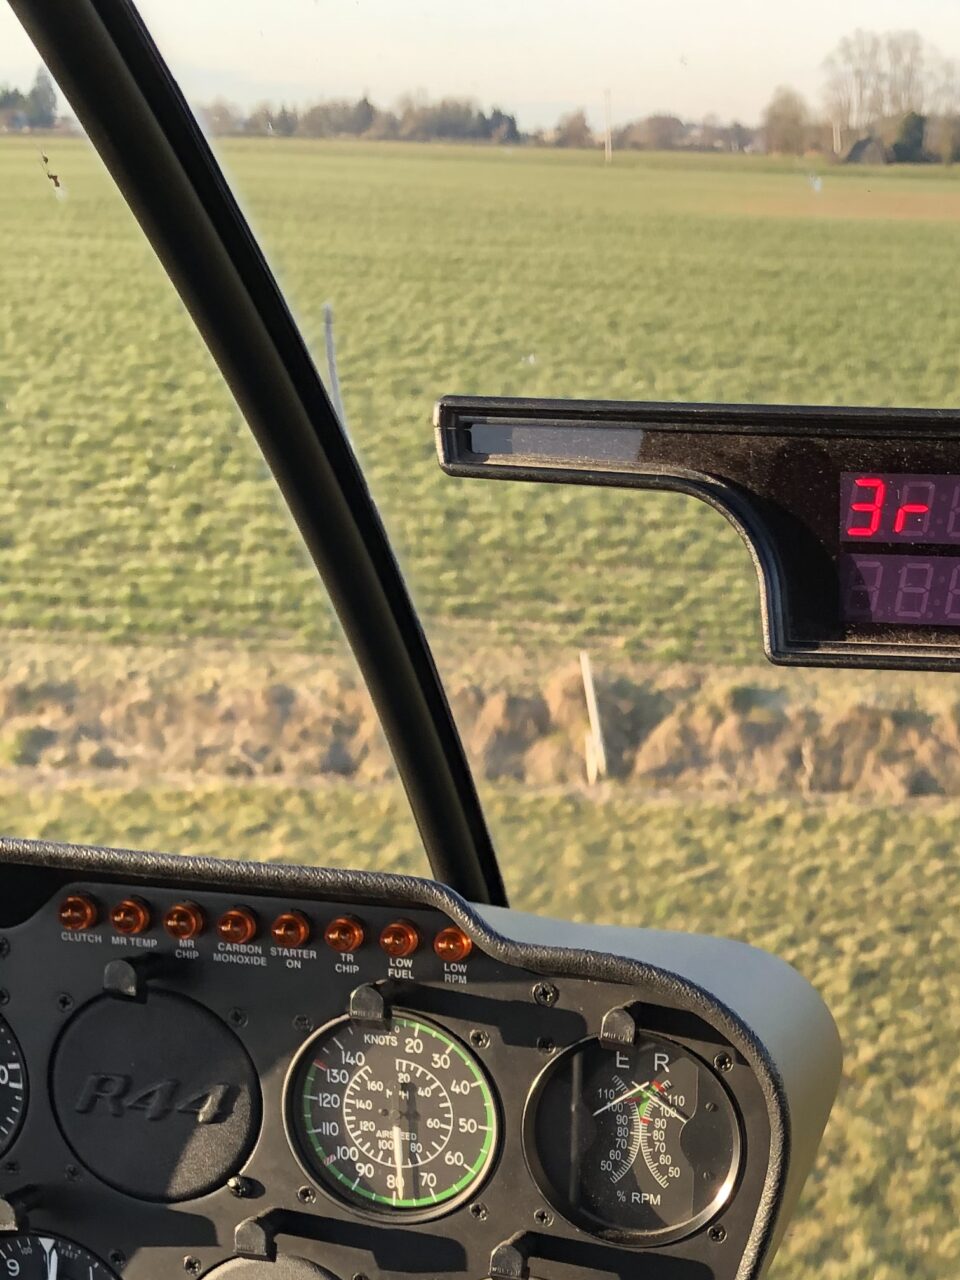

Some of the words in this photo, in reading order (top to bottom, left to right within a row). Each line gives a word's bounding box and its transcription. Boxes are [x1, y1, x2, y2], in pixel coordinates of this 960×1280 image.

[847, 478, 929, 537] 3r
[61, 932, 102, 944] CLUTCH
[112, 936, 127, 946] MR
[130, 938, 158, 948] TEMP
[179, 939, 195, 949] MR
[175, 950, 199, 959] CHIP
[218, 943, 263, 954] CARBON
[270, 947, 317, 959] STARTER
[213, 953, 267, 966] MONOXIDE
[286, 959, 301, 969] ON
[340, 953, 354, 962] TR
[390, 958, 413, 968] LOW
[335, 963, 359, 974] CHIP
[388, 968, 415, 980] FUEL
[444, 963, 467, 973] LOW
[444, 974, 467, 984] RPM
[364, 1034, 398, 1046] KNOTS
[405, 1038, 423, 1053] 20
[342, 1051, 365, 1066] 140
[431, 1054, 450, 1069] 30
[654, 1053, 670, 1072] R
[327, 1069, 349, 1084] 130
[451, 1081, 470, 1095] 40
[75, 1073, 231, 1124] R44
[319, 1093, 340, 1108] 120
[322, 1122, 339, 1135] 110
[459, 1118, 477, 1133] 50
[337, 1147, 359, 1161] 100
[445, 1151, 464, 1166] 60
[355, 1163, 374, 1178] 90
[420, 1173, 437, 1187] 70
[631, 1192, 661, 1206] RPM
